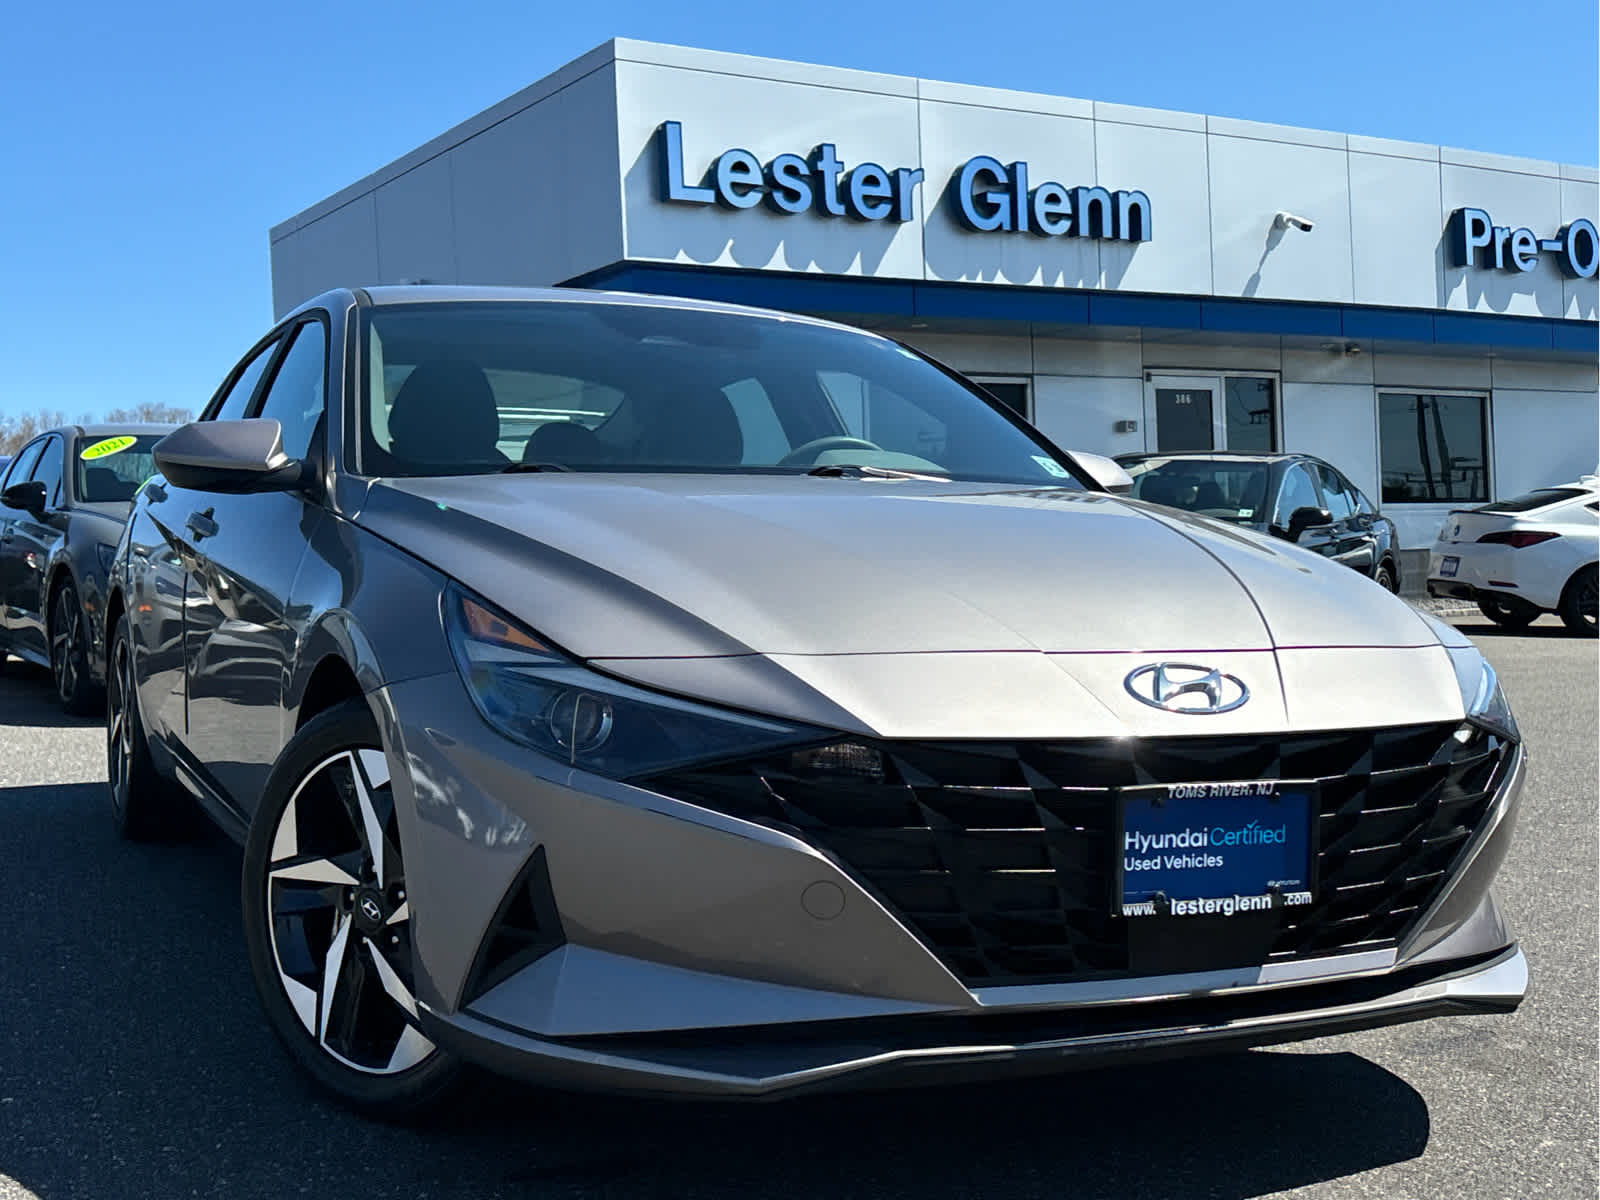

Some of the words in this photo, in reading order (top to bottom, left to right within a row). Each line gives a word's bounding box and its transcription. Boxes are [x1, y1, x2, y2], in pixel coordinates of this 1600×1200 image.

[660, 120, 925, 222] Lester
[954, 155, 1153, 242] Glenn
[95, 439, 125, 455] 2021
[1168, 784, 1207, 798] TOMS
[1125, 827, 1208, 853] Hyundai
[1210, 820, 1286, 846] Certified
[1124, 856, 1161, 871] Used
[1164, 853, 1224, 869] Vehicles
